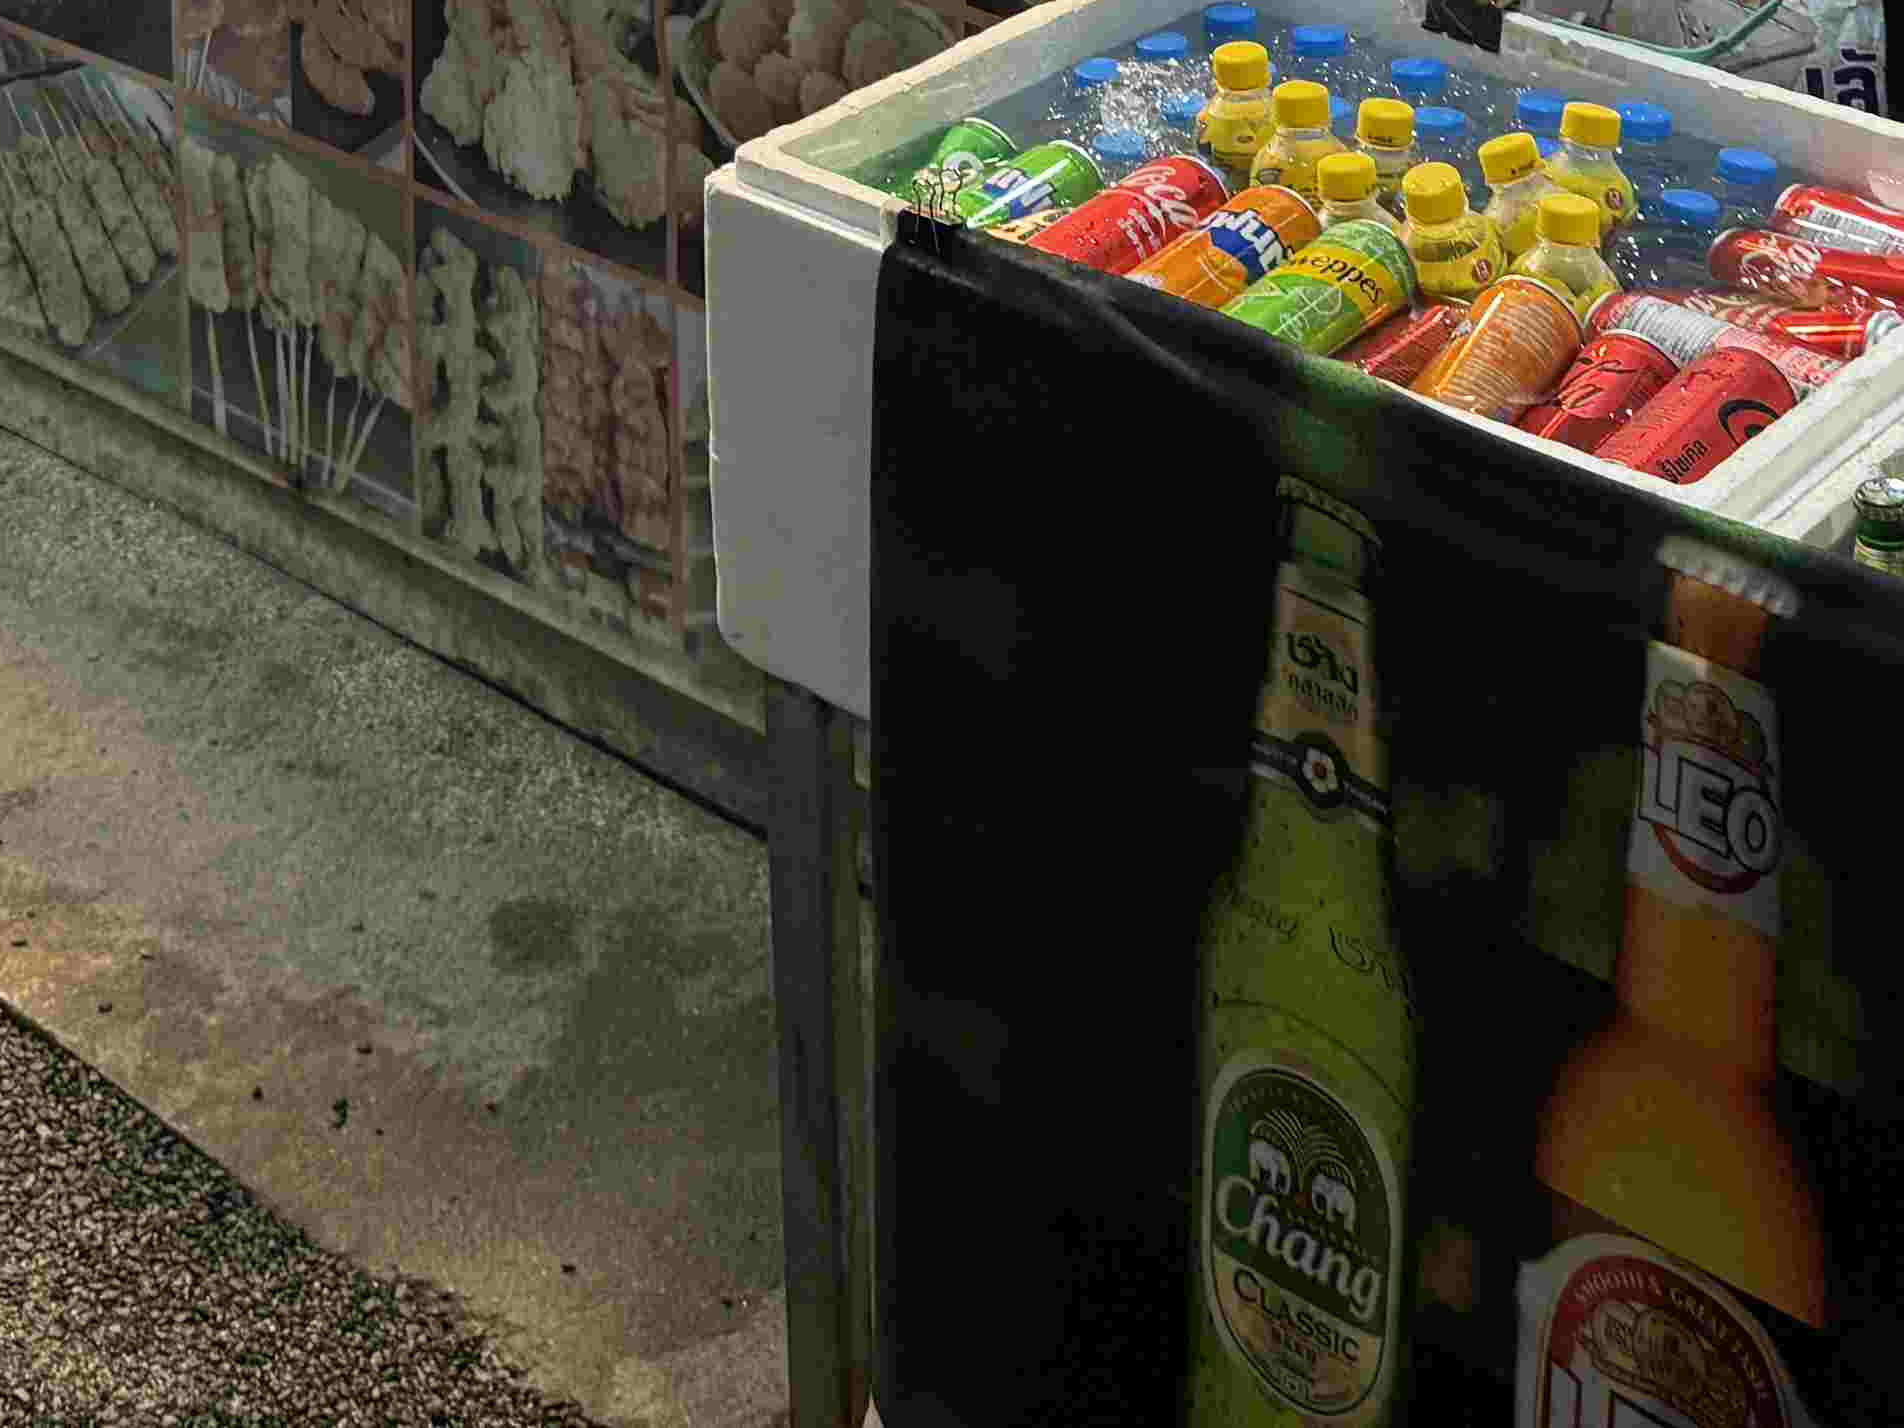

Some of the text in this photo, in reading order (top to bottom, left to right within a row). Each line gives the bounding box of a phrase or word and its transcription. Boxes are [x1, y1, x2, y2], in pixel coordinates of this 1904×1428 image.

[1638, 739, 1778, 875] LEO
[1215, 1173, 1383, 1320] Chang
[1232, 1270, 1360, 1365] CLASSIC
